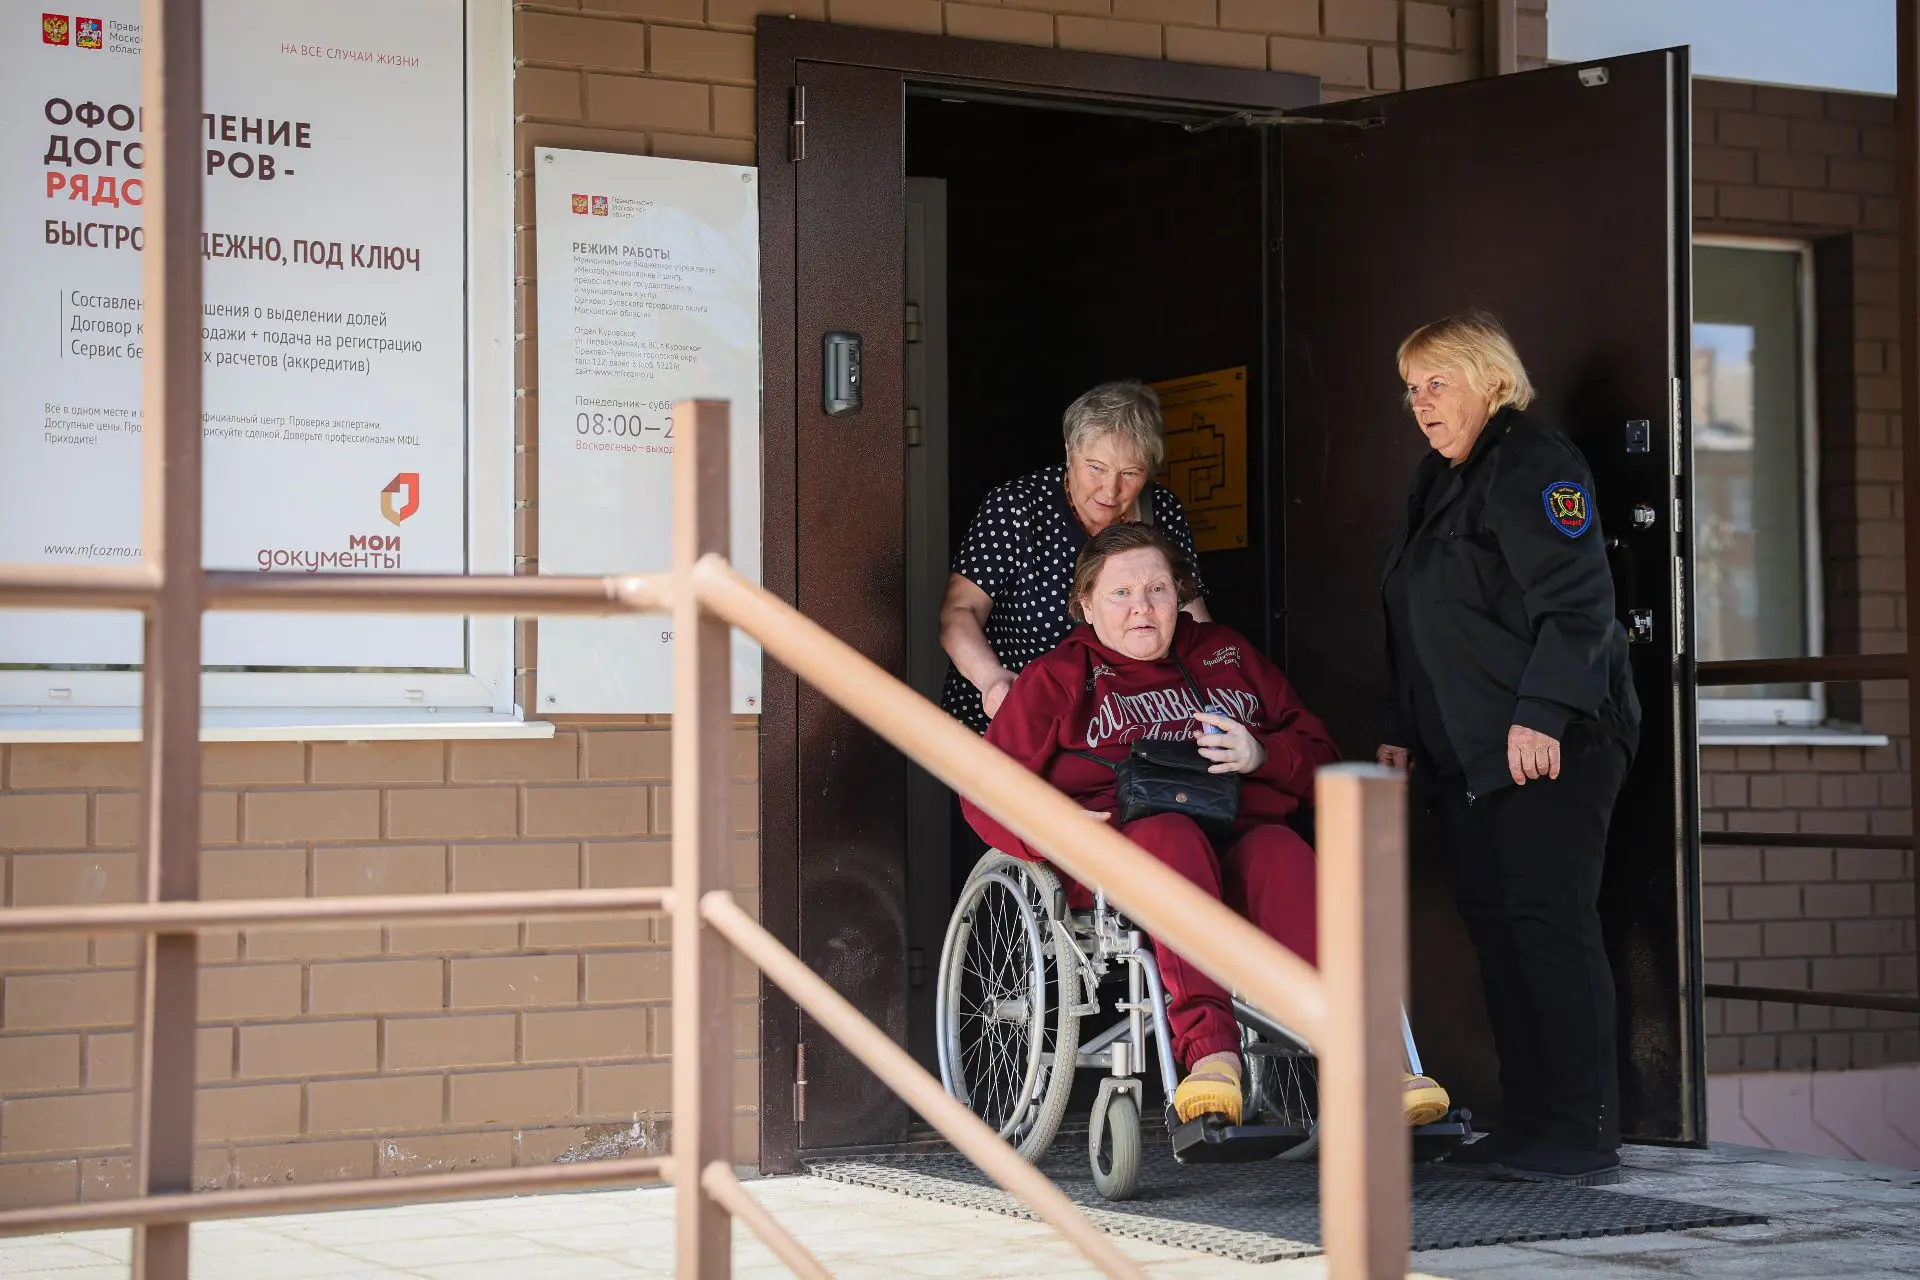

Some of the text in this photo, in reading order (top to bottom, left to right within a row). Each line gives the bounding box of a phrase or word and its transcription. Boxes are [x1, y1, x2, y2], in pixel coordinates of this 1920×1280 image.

[110, 45, 144, 55] област
[281, 43, 420, 68] НА ВСЕ СЛУЧАИ ЖИЗНИ
[45, 98, 311, 149] ОФОЛЕНИЕ
[44, 135, 275, 180] ДОГОРОВ
[46, 171, 144, 208] РЯДО
[201, 232, 288, 266] ДЕЖНО,
[293, 239, 344, 270] ПОД
[351, 243, 420, 272] КЛЮЧ
[572, 242, 671, 260] РЕЖИМ РАБОТЫ
[71, 290, 145, 311] Составлен
[254, 307, 262, 319] о
[267, 308, 342, 324] выделении
[346, 311, 387, 327] долей
[70, 315, 132, 338] Договор
[263, 331, 311, 347] подача
[316, 335, 332, 347] на
[336, 336, 422, 354] регистрацию
[574, 326, 637, 338] Отдел Куровское
[71, 339, 123, 360] Сервис
[216, 351, 278, 368] расчетов
[283, 352, 370, 376] (аккредитив)
[44, 417, 94, 431] Доступные
[203, 428, 243, 439] рискуйте
[283, 429, 323, 442] Доверьте
[324, 432, 395, 445] профессионалам
[397, 435, 421, 446] МФЦ.
[63, 406, 69, 414] в
[71, 406, 101, 416] одном
[103, 408, 129, 417] месте
[131, 409, 137, 418] и
[202, 411, 258, 424] фициальный
[289, 415, 330, 429] Проверка
[332, 419, 382, 431] экспертами.
[44, 432, 97, 445] Приходите!
[257, 549, 401, 573] документы
